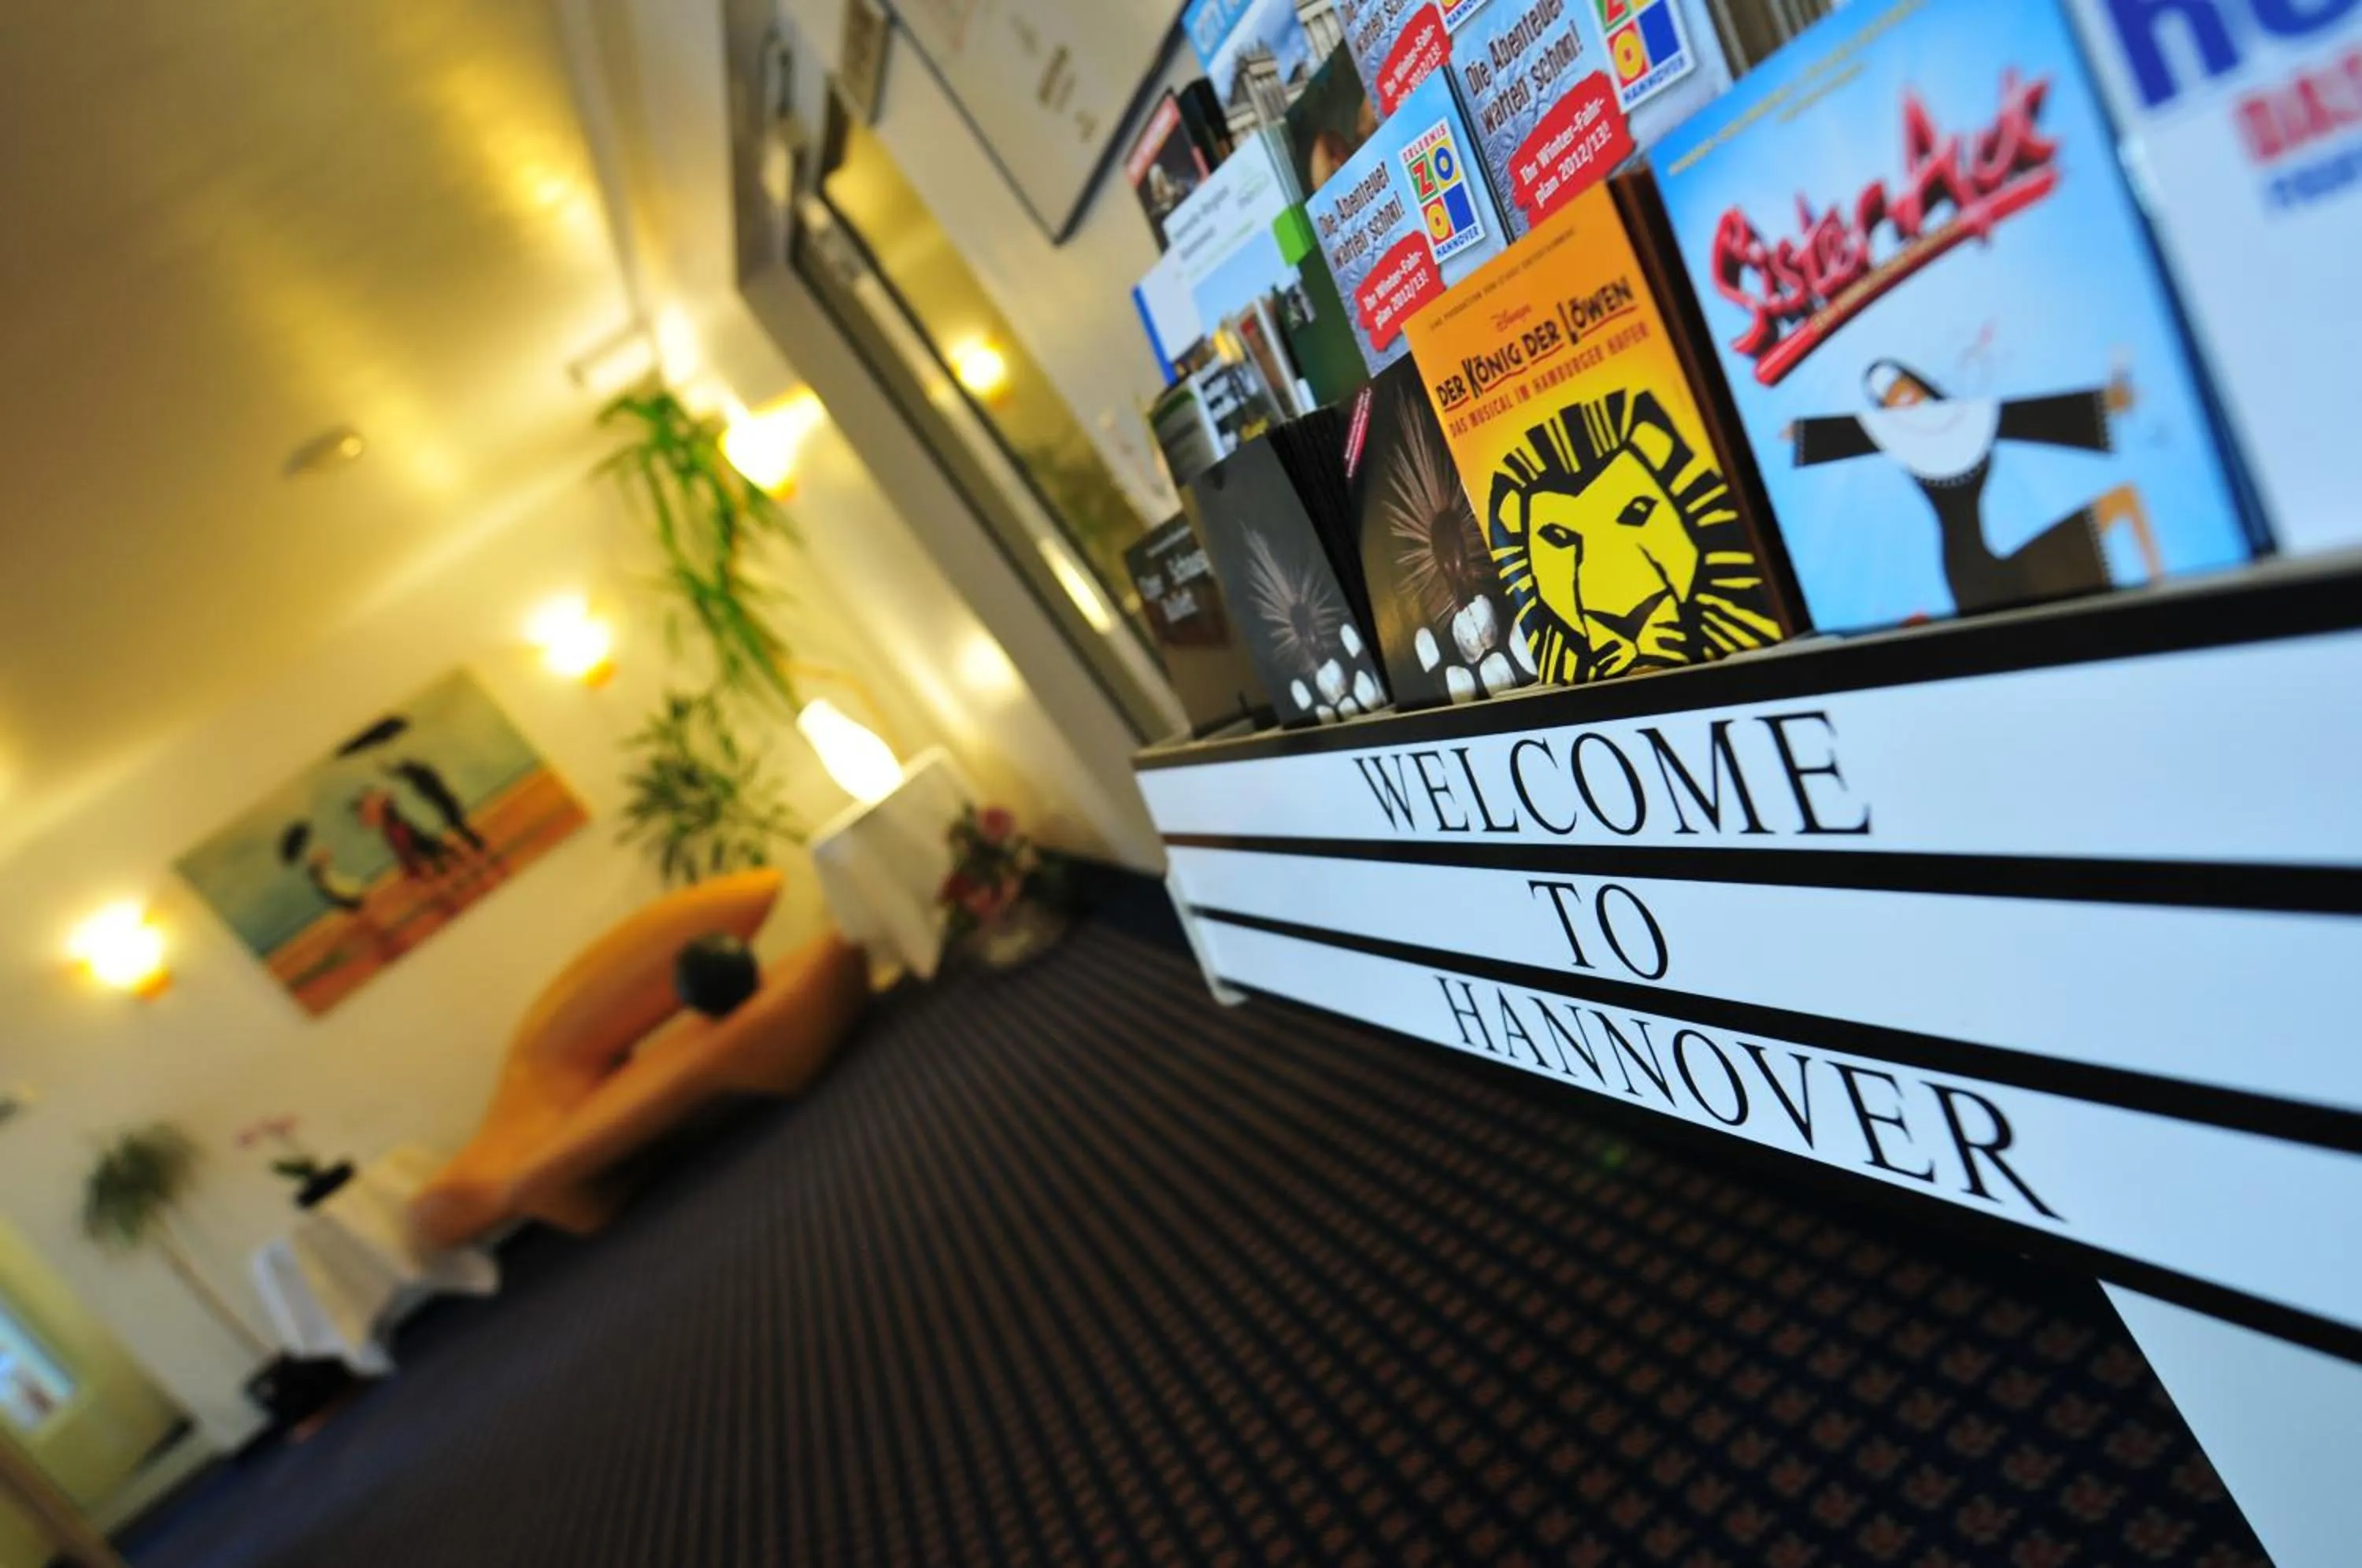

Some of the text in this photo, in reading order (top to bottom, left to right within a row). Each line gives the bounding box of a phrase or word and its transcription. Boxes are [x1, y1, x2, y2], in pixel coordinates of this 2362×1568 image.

[1464, 59, 1492, 97] Die
[1480, 76, 1531, 136] warten
[1520, 98, 1605, 187] Ihr Winter-Fahr-
[1535, 119, 1613, 210] plan 2012/13!
[1435, 226, 1479, 258] HANNOVER
[1711, 179, 1888, 359] Sister
[1888, 67, 2059, 244] Act
[1435, 275, 1635, 407] DER KÖNIG DER LÖWEN
[1449, 416, 1468, 438] DAS
[1468, 398, 1514, 428] MUSICAL
[1531, 344, 1605, 394] HAMBURGER
[1352, 709, 1873, 838] WELCOME
[1527, 878, 1670, 982] TO
[1434, 974, 2070, 1224] HANNOVER
